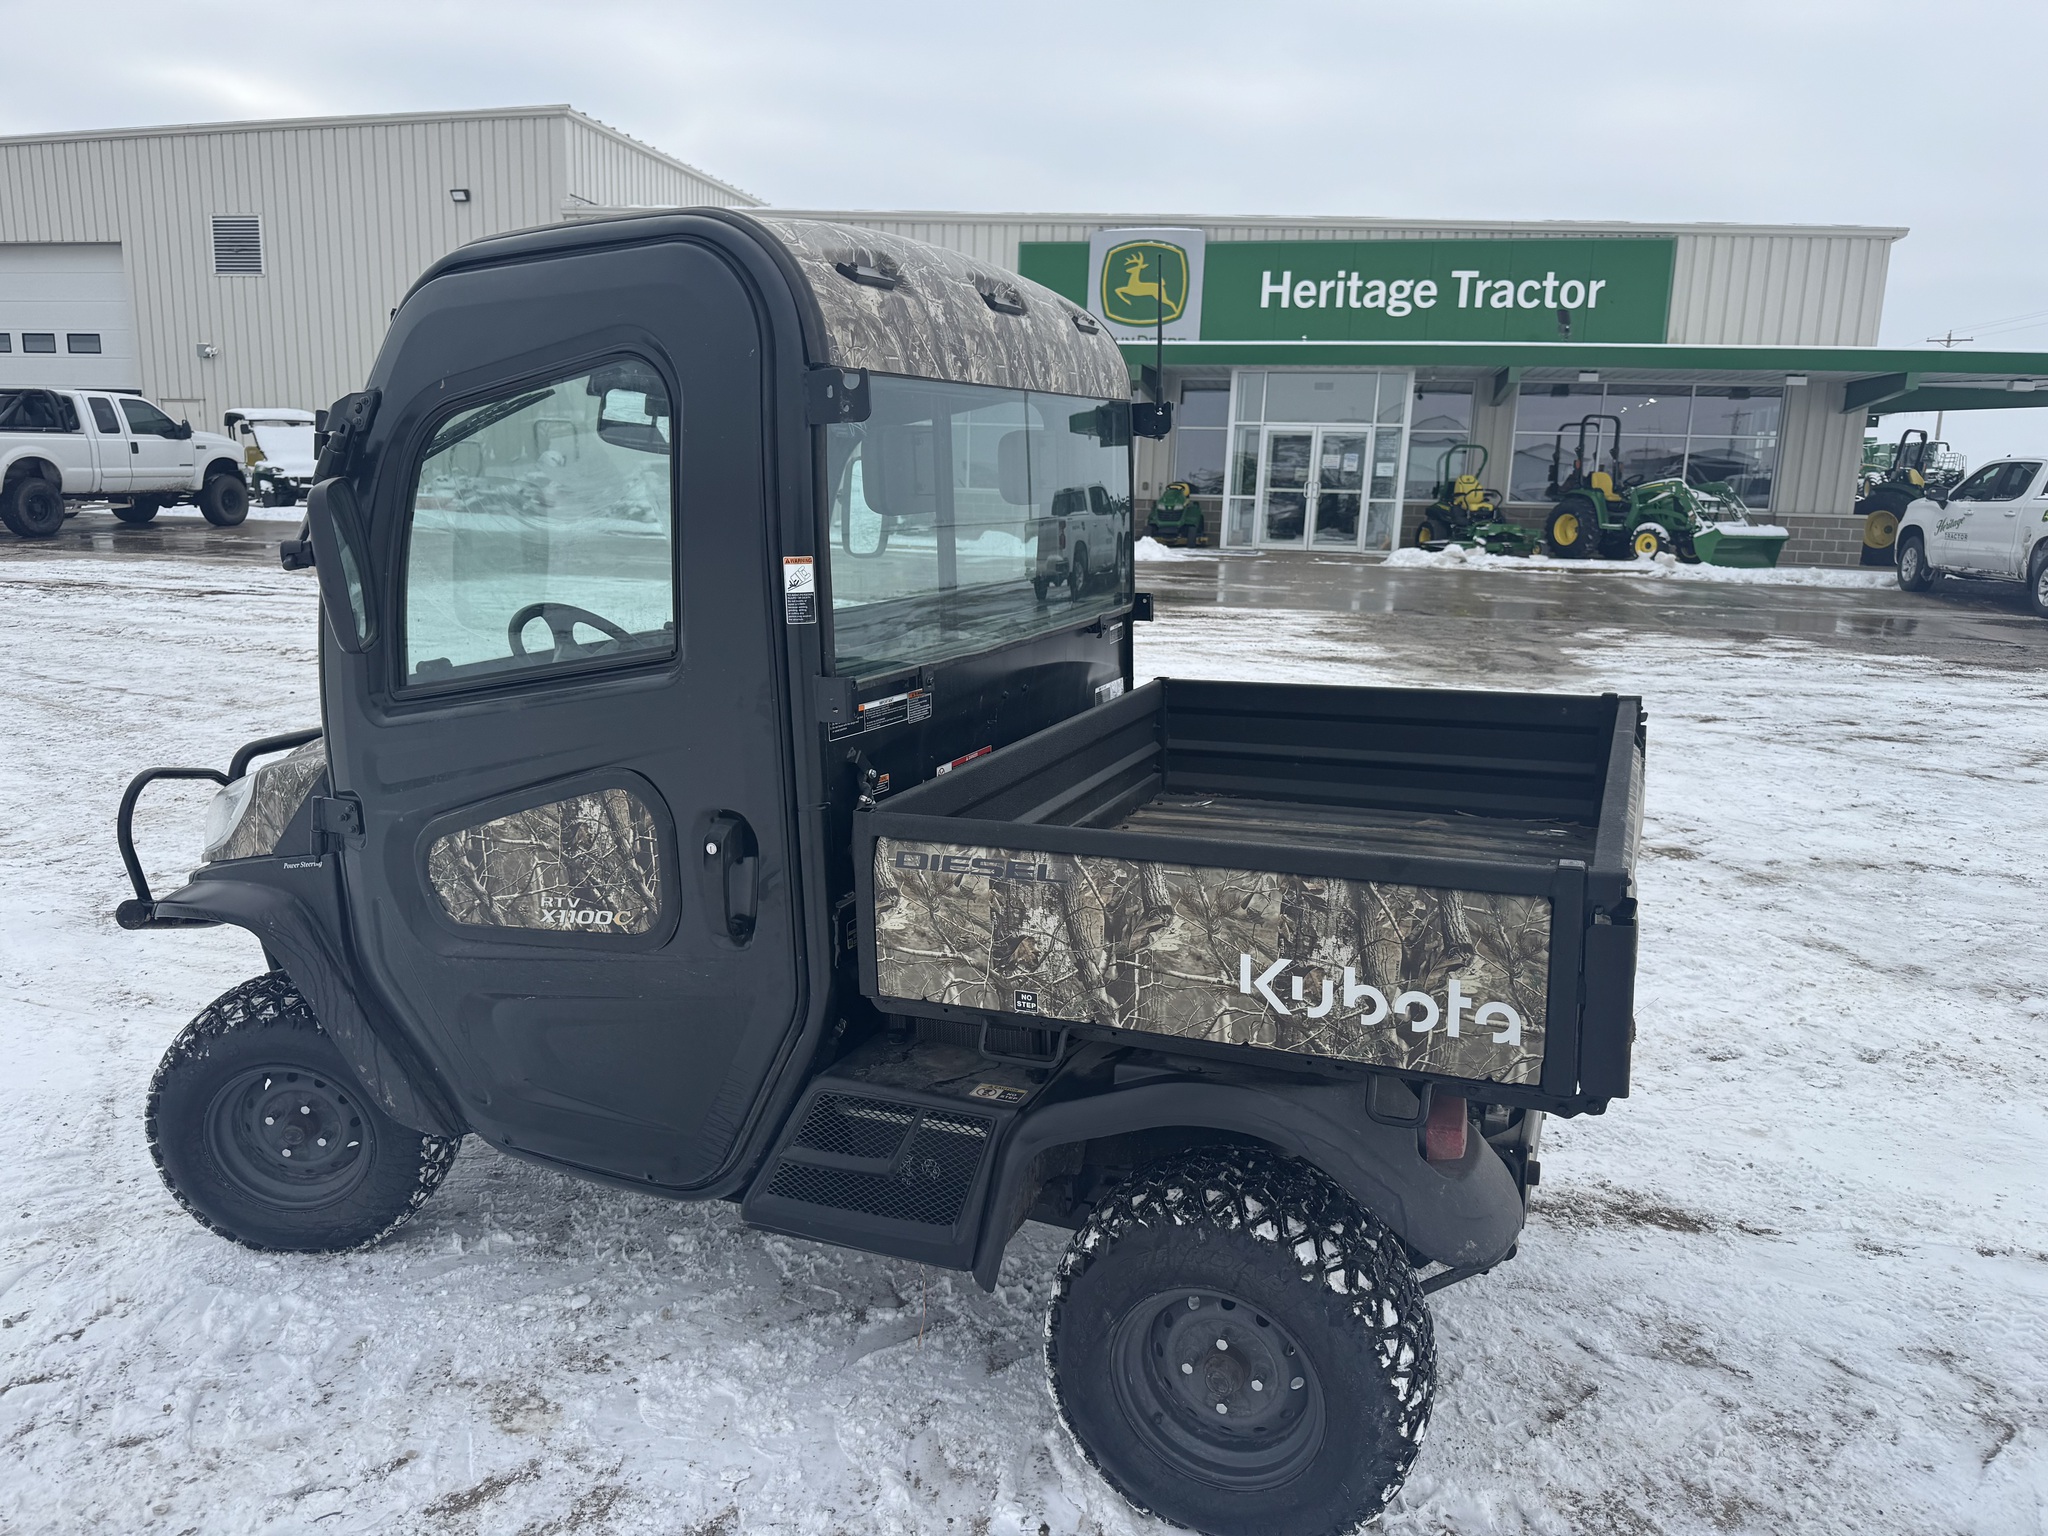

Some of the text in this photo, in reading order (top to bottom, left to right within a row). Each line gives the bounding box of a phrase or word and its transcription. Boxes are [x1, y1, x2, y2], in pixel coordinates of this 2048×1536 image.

[1260, 269, 1607, 318] Heritage Tractor
[1944, 532, 1968, 540] TRACTOR
[895, 850, 1069, 884] DIESEL
[541, 896, 581, 909] RTV
[540, 908, 631, 926] X1100C
[1016, 1000, 1037, 1009] STEP
[1021, 993, 1032, 1001] NO
[1239, 953, 1522, 1047] Kubota
